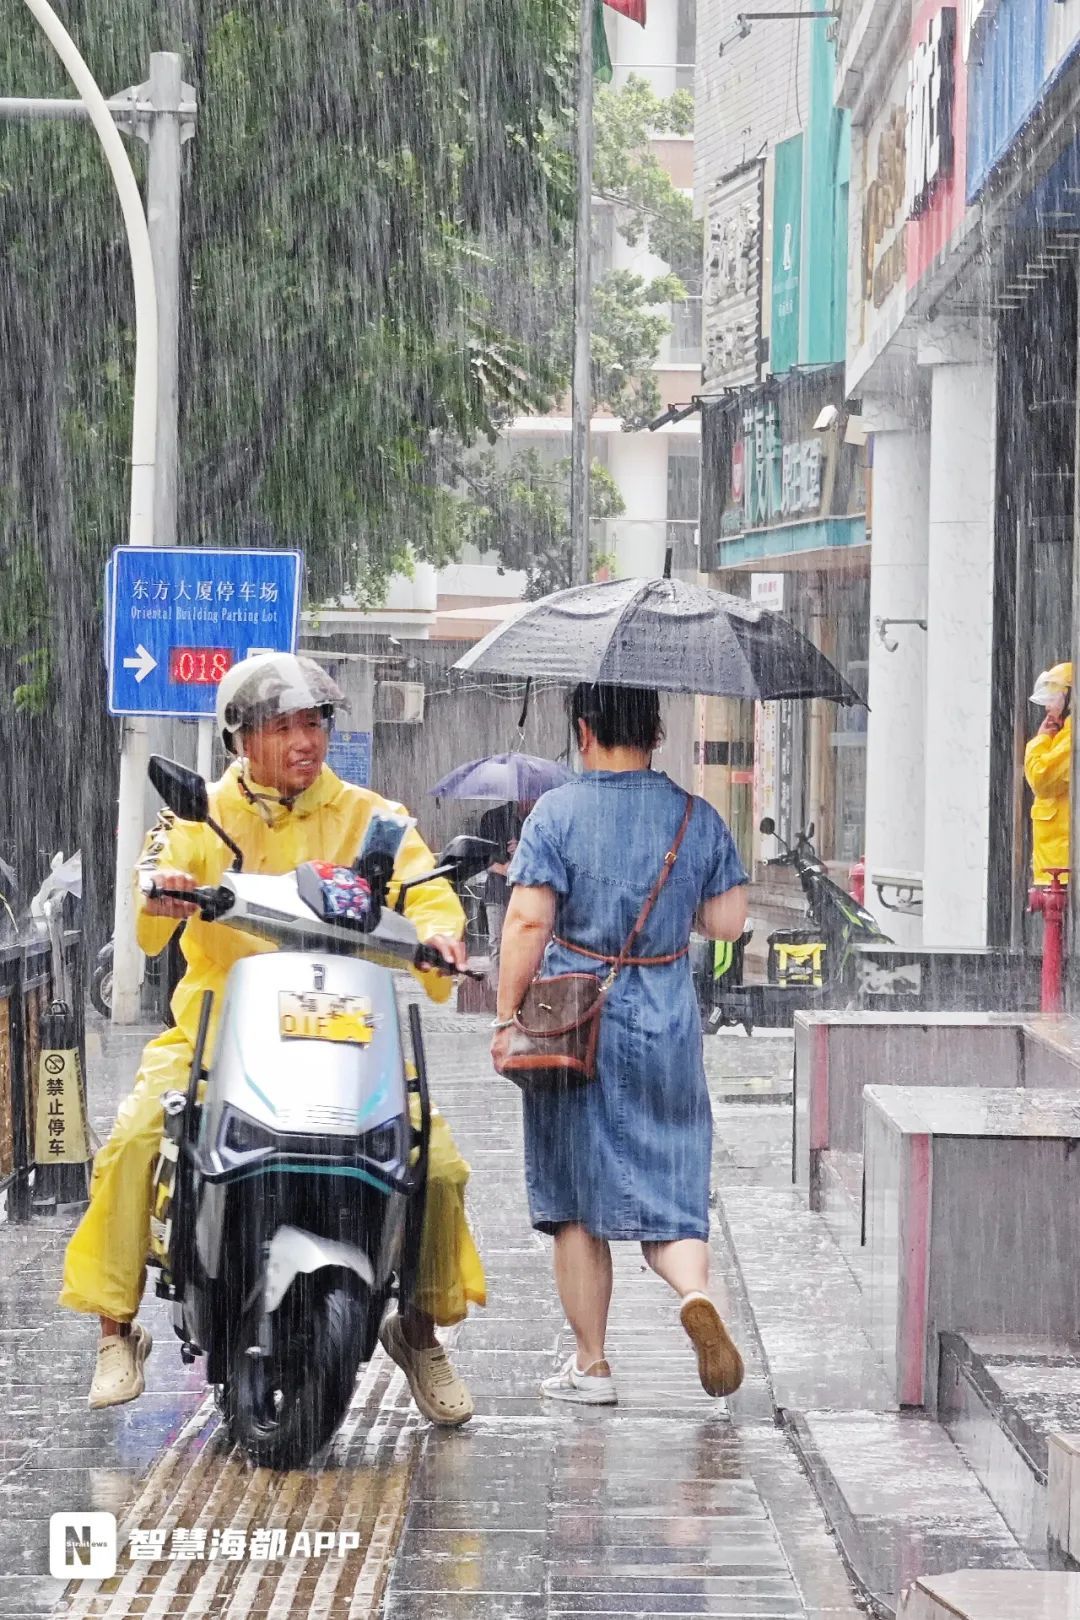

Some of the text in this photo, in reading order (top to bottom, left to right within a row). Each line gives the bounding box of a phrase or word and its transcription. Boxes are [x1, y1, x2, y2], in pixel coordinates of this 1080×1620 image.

[131, 579, 279, 603] 东方大厦停车场
[131, 606, 278, 624] Oriental Building Parking Lot
[179, 652, 227, 682] 018
[46, 1077, 66, 1156] 禁止停车
